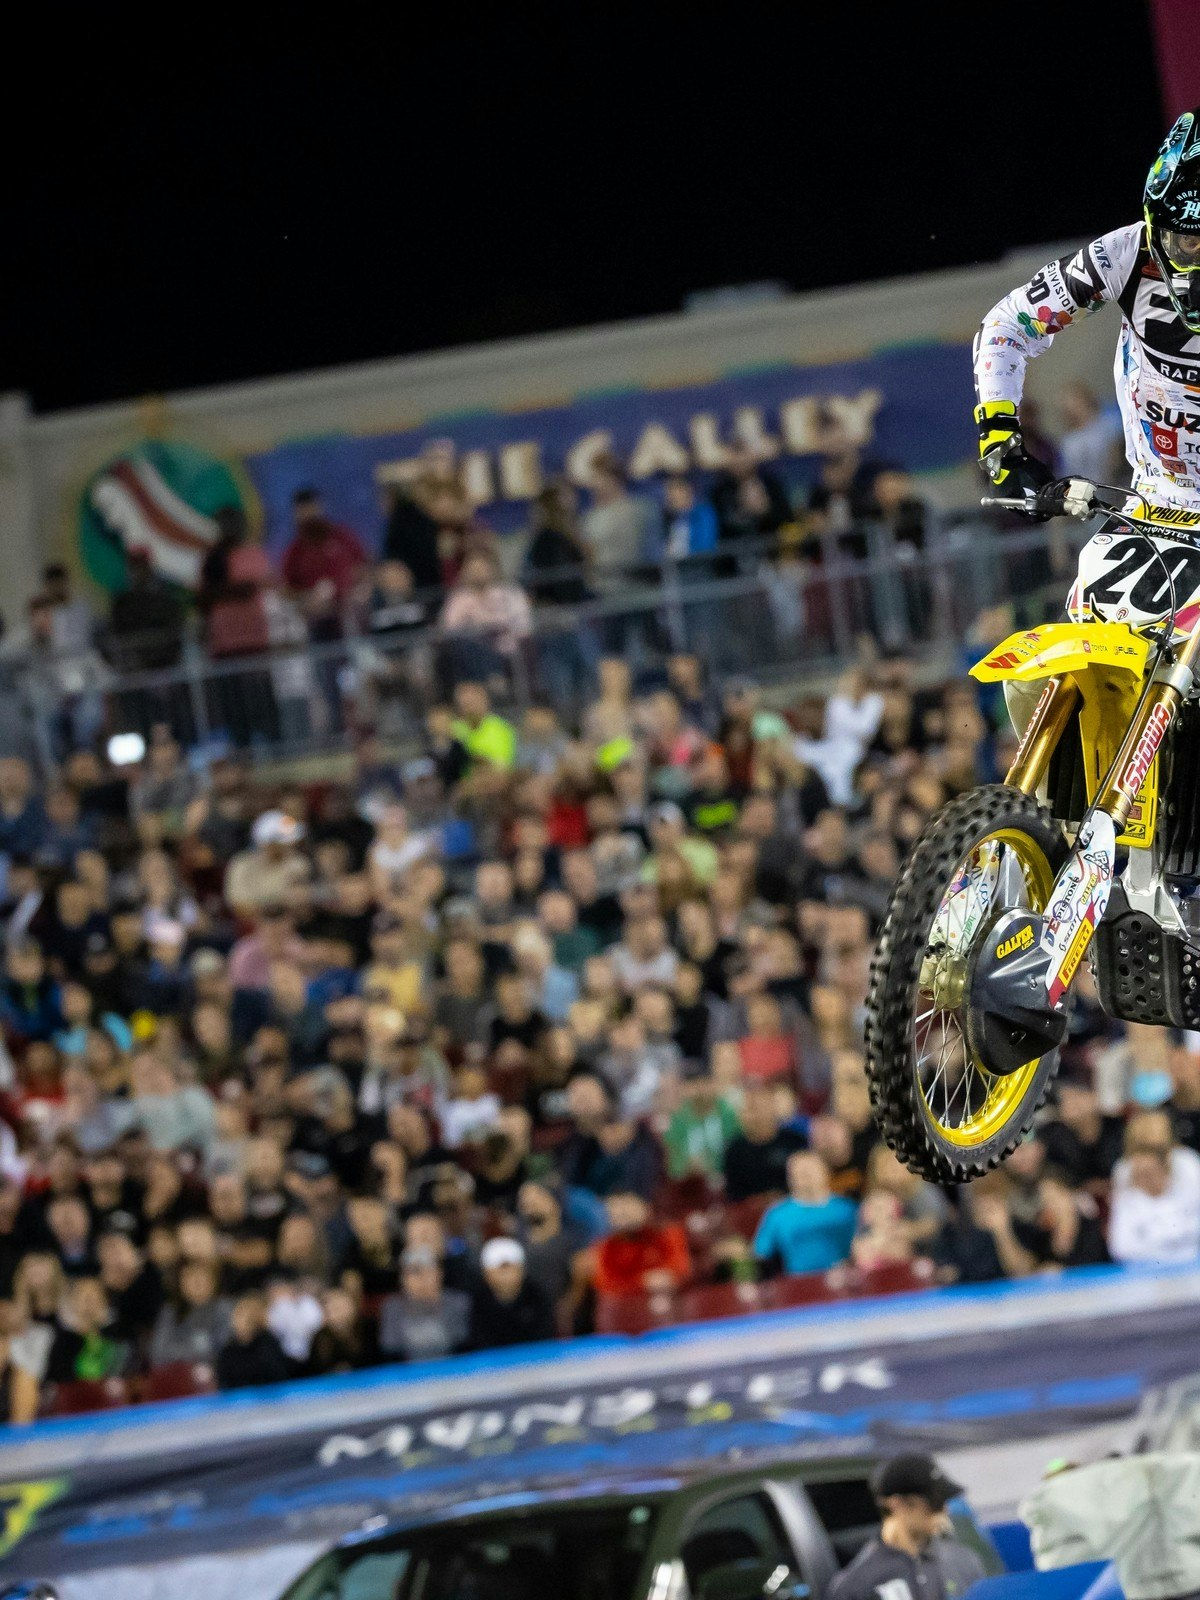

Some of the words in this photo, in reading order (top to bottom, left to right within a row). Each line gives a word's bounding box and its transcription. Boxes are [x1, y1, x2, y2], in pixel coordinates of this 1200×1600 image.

[1122, 700, 1173, 799] SHOWA
[996, 925, 1035, 960] GALFER
[1062, 924, 1093, 982] PIRELLI
